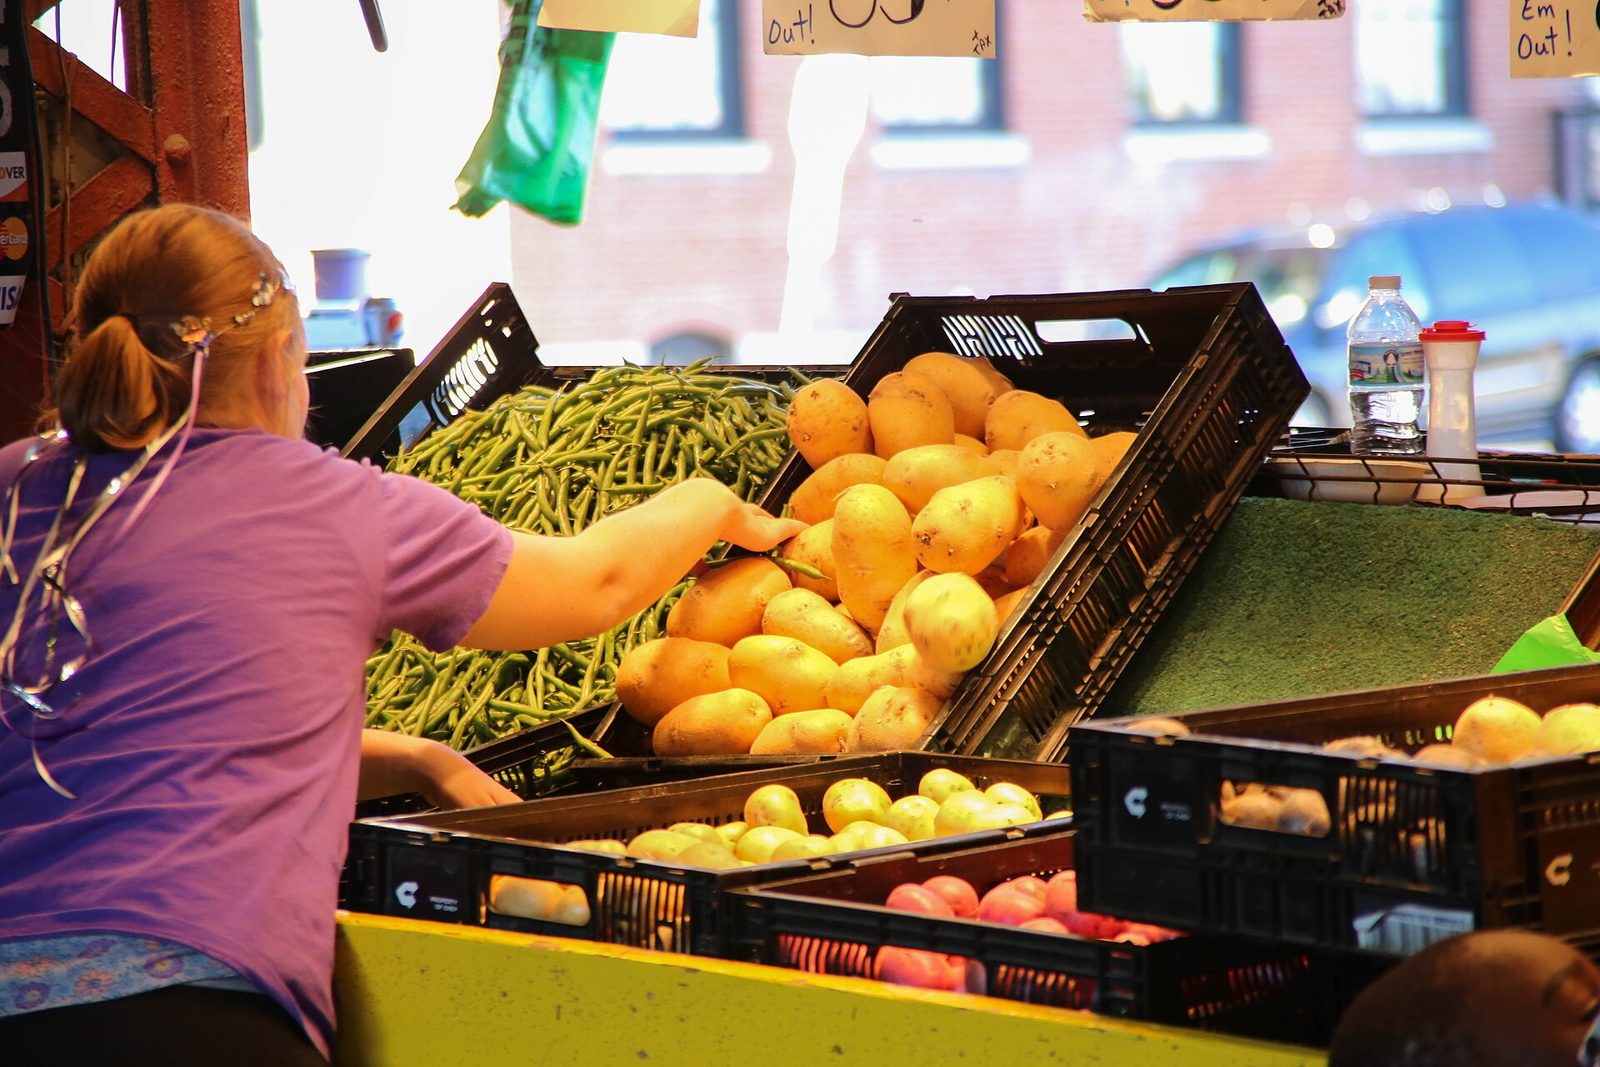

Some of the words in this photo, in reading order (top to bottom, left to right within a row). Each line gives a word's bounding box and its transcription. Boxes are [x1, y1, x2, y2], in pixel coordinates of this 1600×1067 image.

[768, 4, 815, 44] Out!
[1522, 0, 1555, 20] Em
[973, 35, 992, 55] TAX
[1518, 9, 1572, 59] Out!
